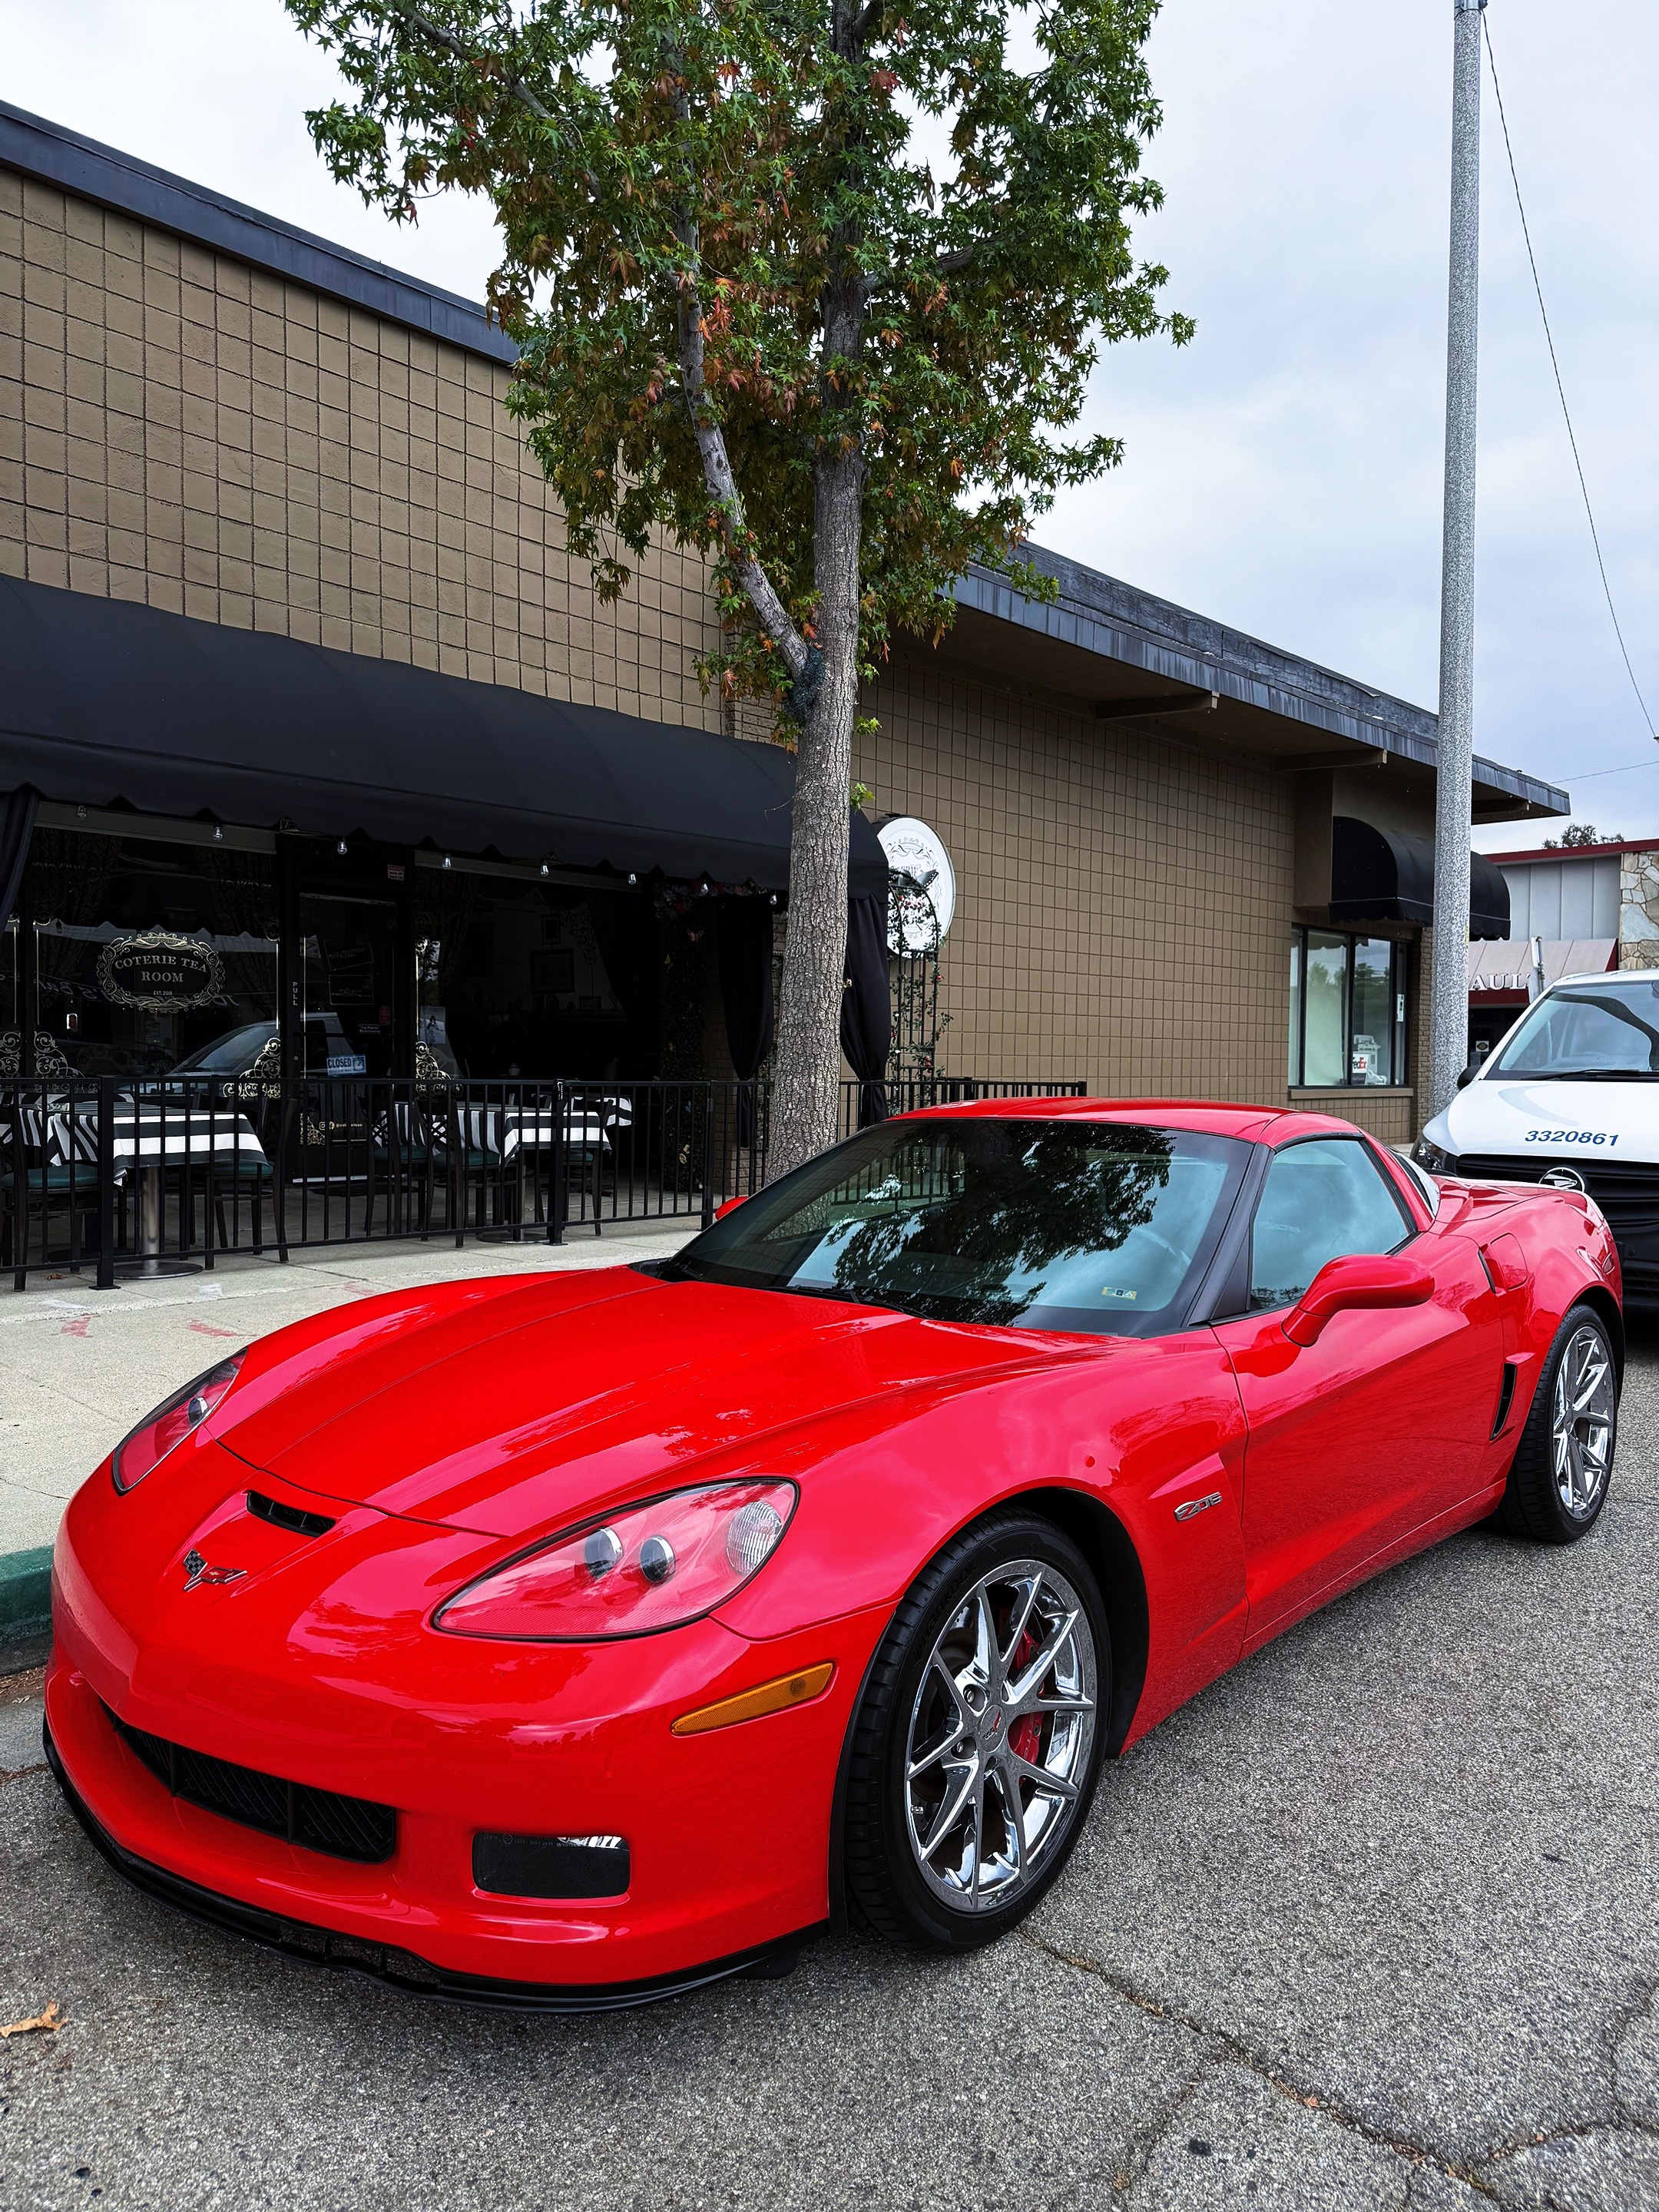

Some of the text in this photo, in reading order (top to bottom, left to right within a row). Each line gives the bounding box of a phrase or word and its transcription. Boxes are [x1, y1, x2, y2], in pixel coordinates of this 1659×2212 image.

[114, 955, 207, 973] COTERIE TEA
[141, 971, 184, 983] ROOM
[1469, 973, 1531, 991] AUL
[328, 1058, 352, 1068] CLOSED
[1525, 1130, 1619, 1147] 3320861
